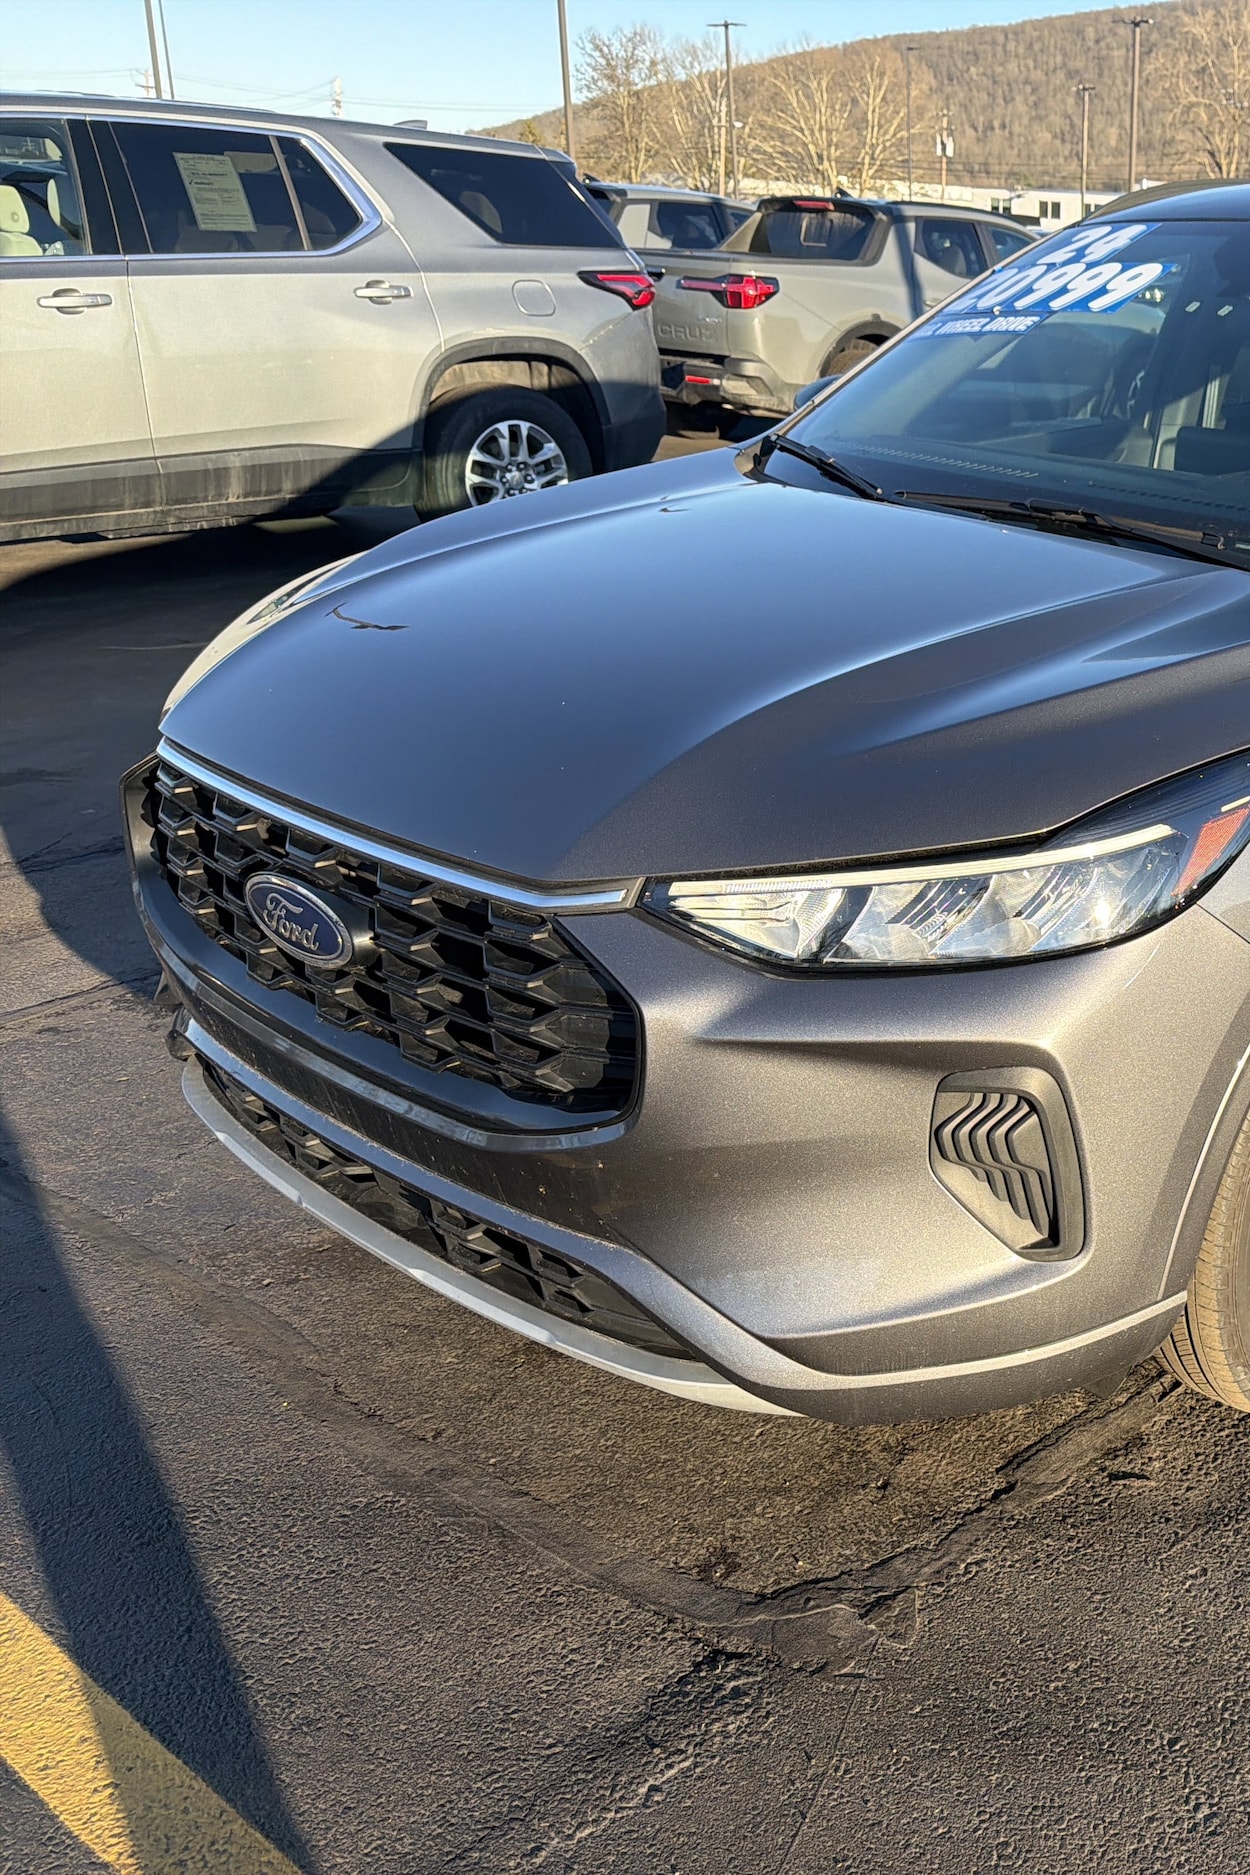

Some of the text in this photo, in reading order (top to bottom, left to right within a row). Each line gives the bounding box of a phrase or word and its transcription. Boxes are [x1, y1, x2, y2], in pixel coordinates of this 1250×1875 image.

[1036, 224, 1148, 265] 24
[942, 262, 1163, 313] 20999
[981, 316, 1041, 332] DRIVE
[263, 892, 320, 951] Ford
